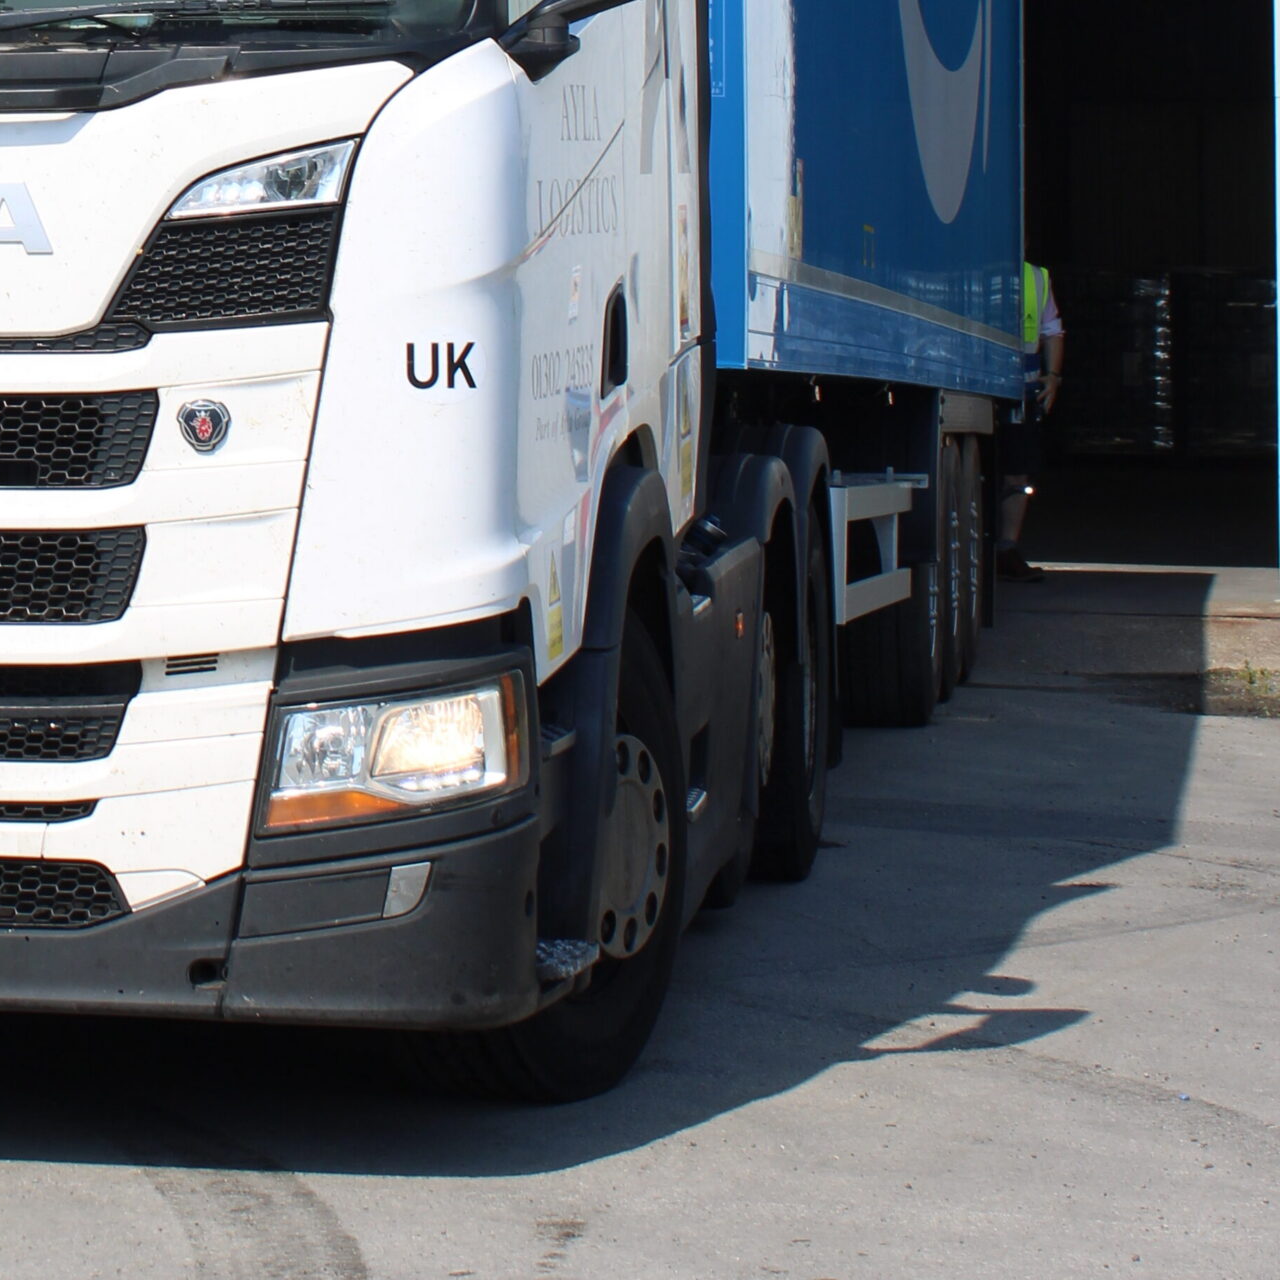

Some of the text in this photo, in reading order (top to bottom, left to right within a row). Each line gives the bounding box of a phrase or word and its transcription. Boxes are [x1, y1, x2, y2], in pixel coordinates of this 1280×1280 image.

[560, 84, 601, 141] AYLA
[536, 174, 618, 238] LOGISTICS
[406, 342, 477, 389] UK
